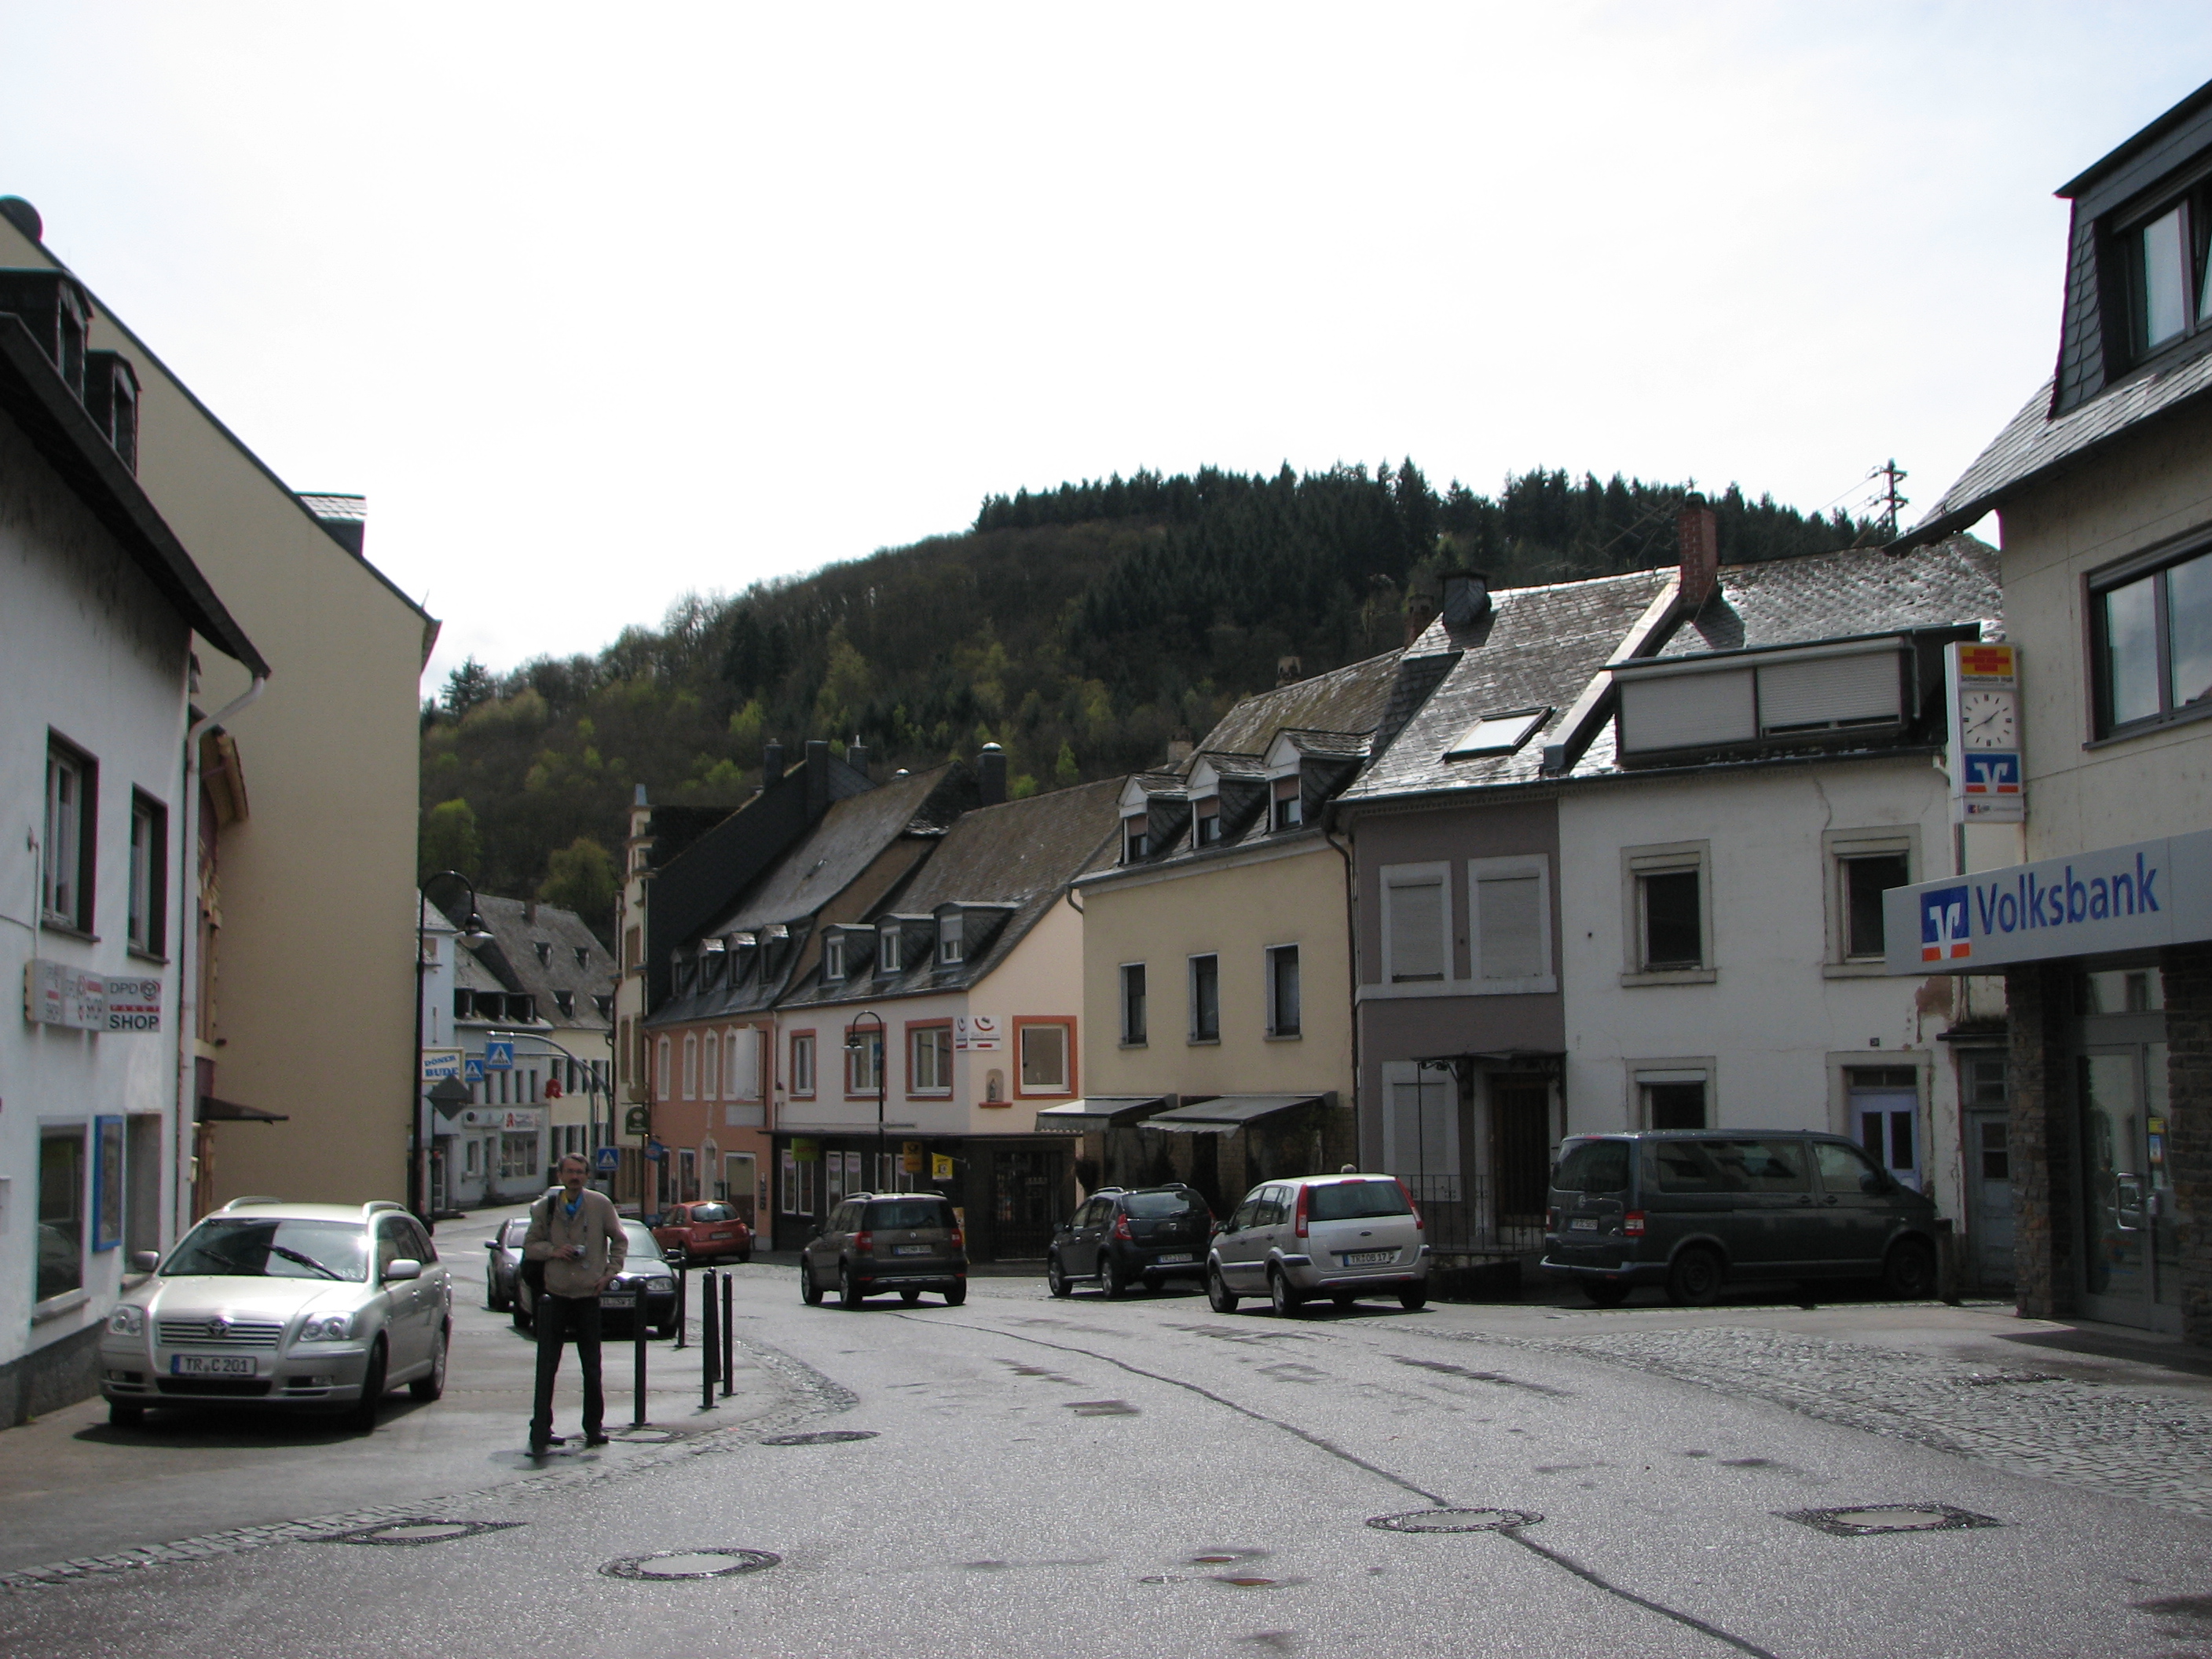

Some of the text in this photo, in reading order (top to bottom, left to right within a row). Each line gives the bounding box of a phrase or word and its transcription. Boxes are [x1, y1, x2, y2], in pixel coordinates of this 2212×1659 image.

[1976, 852, 2160, 935] Volksbank
[110, 982, 138, 994] DPD
[109, 1014, 159, 1029] SHOP
[425, 1067, 459, 1077] BUDE
[185, 1357, 248, 1373] TR C 201
